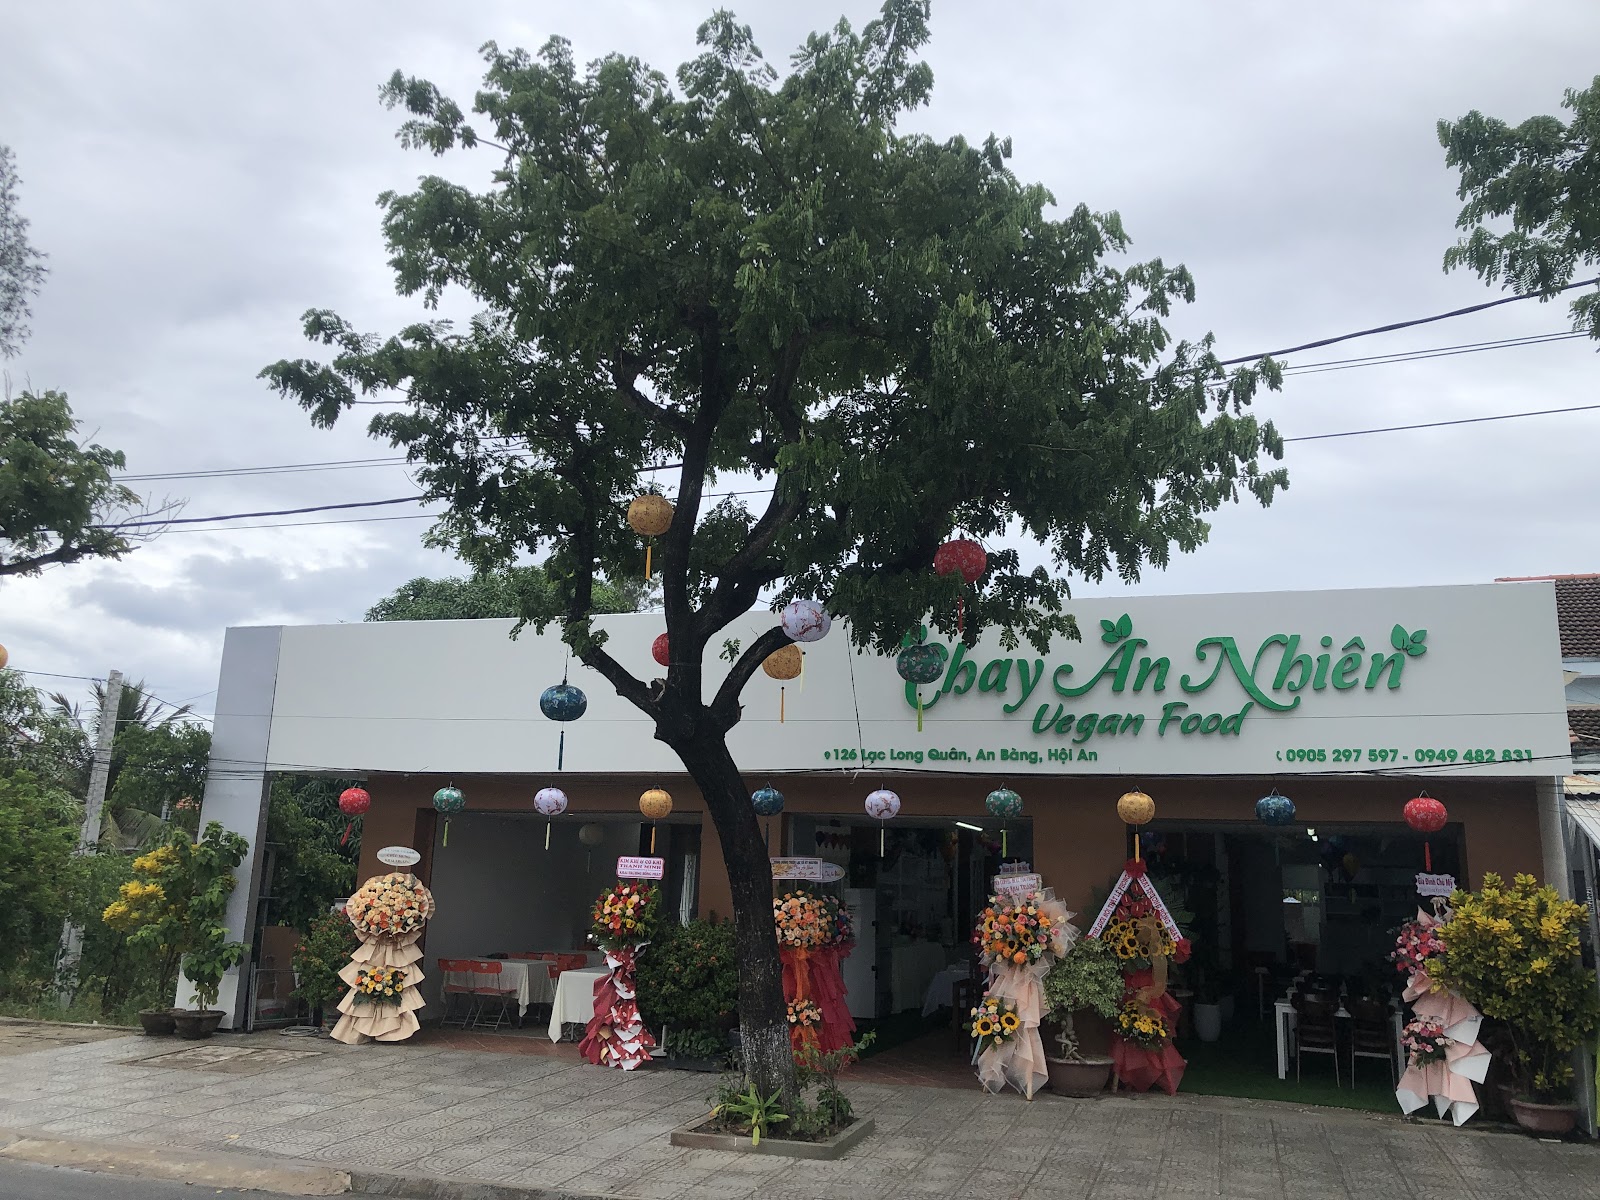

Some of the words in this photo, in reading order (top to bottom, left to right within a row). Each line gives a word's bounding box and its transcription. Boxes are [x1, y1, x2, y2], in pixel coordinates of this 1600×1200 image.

[1180, 634, 1406, 711] Nhiên
[1032, 703, 1146, 744] Vegan
[1158, 702, 1255, 736] Food
[833, 748, 858, 761] 126
[890, 748, 924, 764] Long
[927, 747, 967, 763] Quân,
[975, 748, 996, 761] An
[1047, 747, 1073, 764] Hội
[1077, 748, 1098, 761] An
[1286, 748, 1327, 762] 0905
[1332, 748, 1362, 762] 297
[1368, 748, 1399, 762] 597
[1414, 748, 1458, 762] 0949
[1462, 748, 1496, 764] 482
[1501, 748, 1533, 763] 831
